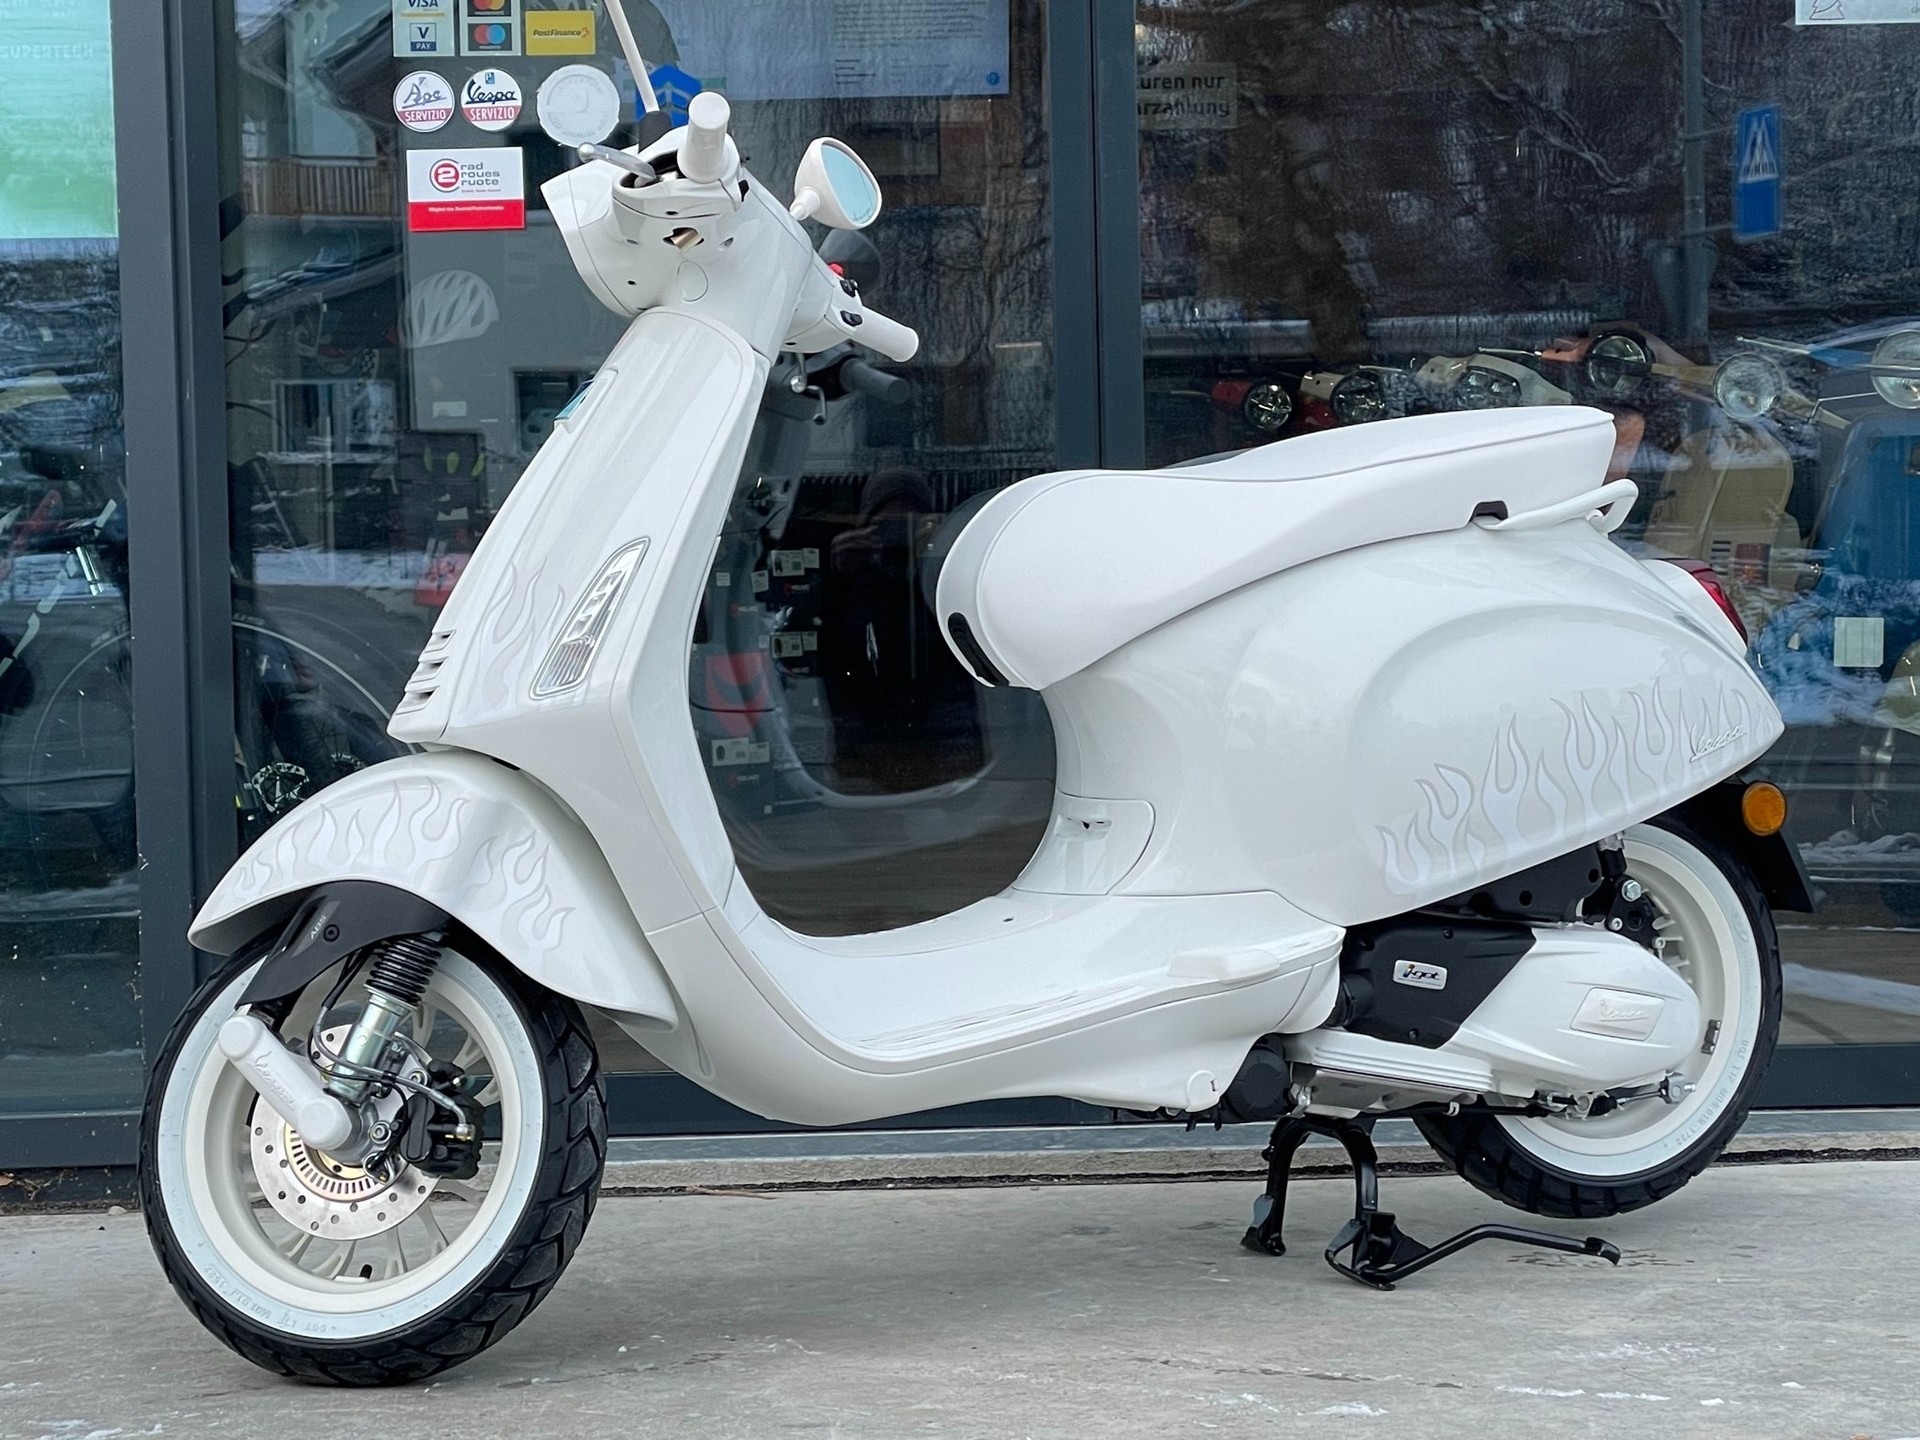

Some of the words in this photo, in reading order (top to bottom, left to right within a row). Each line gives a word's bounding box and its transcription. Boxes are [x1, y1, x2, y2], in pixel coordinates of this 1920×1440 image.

[416, 26, 429, 39] V
[1137, 76, 1185, 89] uren
[1191, 76, 1225, 89] nur
[465, 79, 518, 104] Vespa
[405, 109, 446, 122] SERVIZIO
[470, 106, 515, 121] SERVIZIO
[460, 162, 483, 170] rad
[461, 178, 499, 186] ruote
